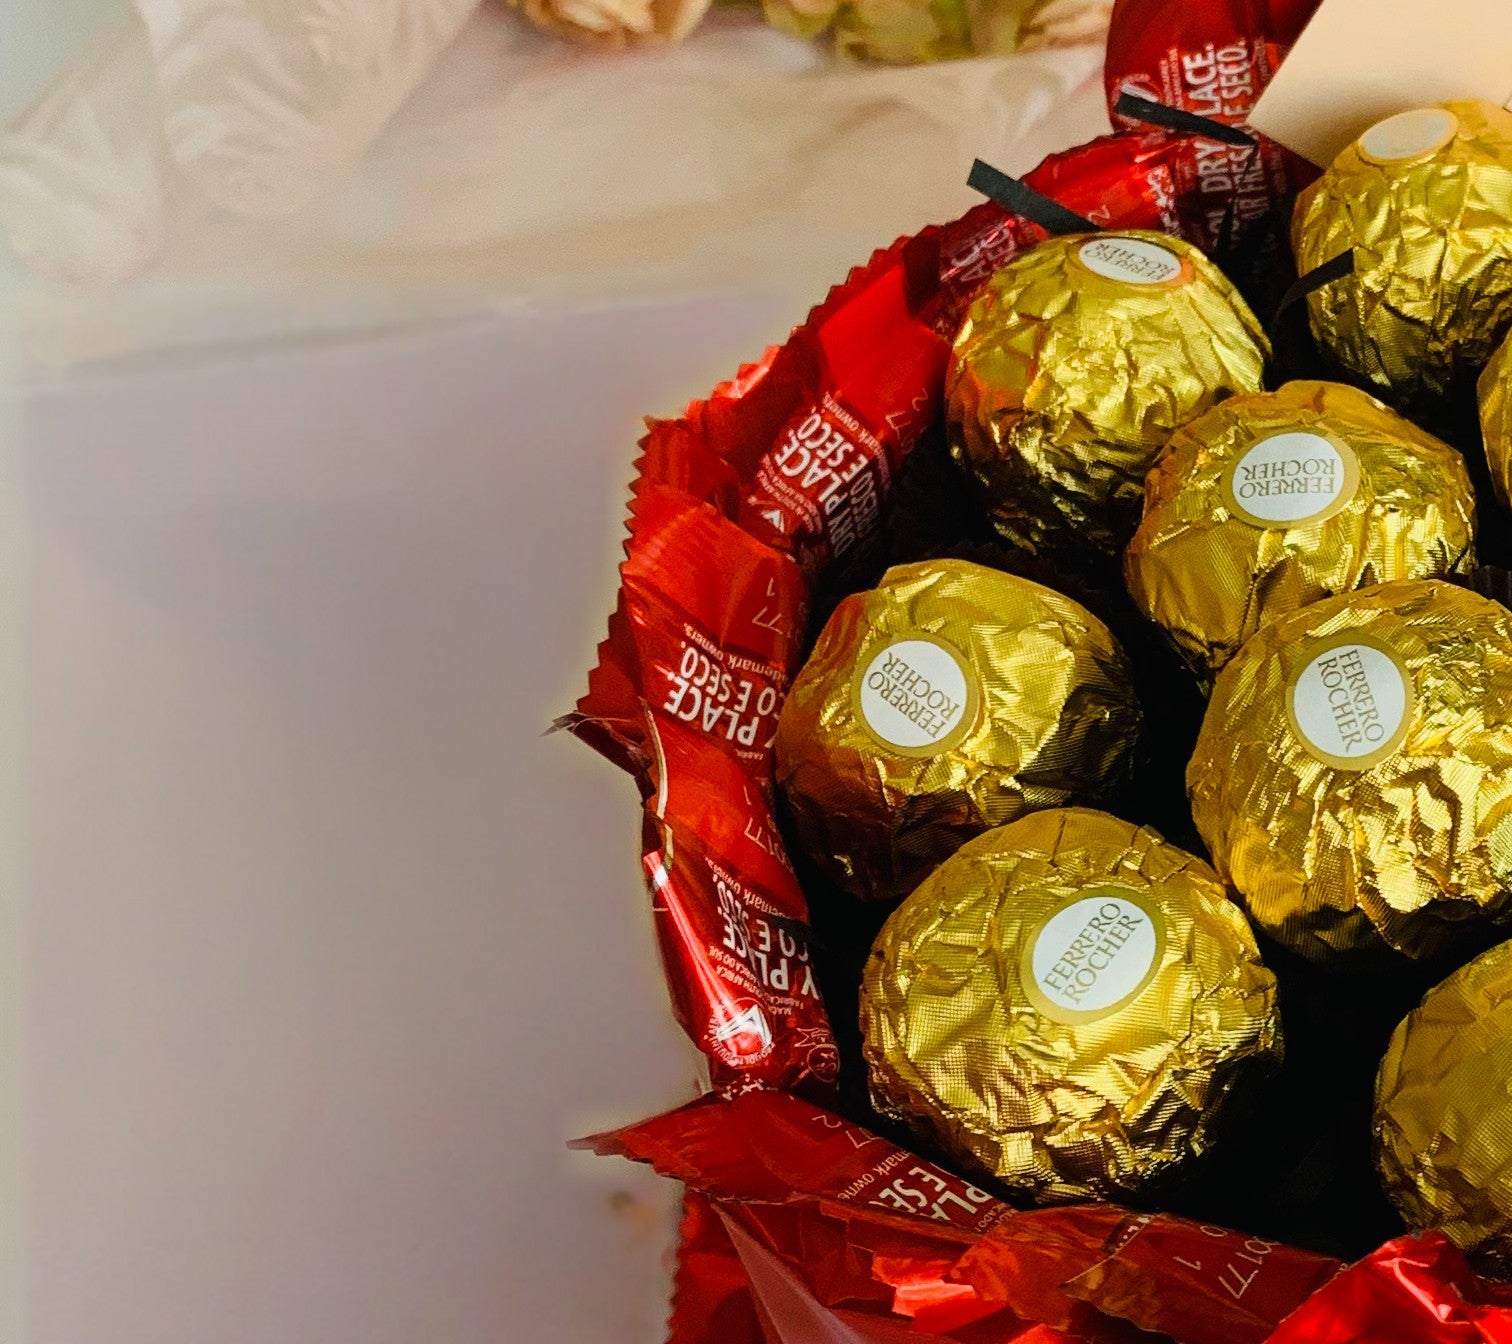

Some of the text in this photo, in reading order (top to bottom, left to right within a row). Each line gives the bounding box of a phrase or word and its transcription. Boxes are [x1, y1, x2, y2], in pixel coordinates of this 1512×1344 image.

[1183, 42, 1222, 117] LACE.
[774, 428, 848, 516] PLACE.
[797, 406, 854, 468] SECO.
[1240, 458, 1336, 481] ROCHER
[1239, 477, 1335, 499] FERRERO
[663, 671, 760, 747] PLACE.
[679, 640, 733, 703] SECO.
[868, 671, 946, 739] FERRERO
[882, 651, 960, 721] ROCHER
[1317, 657, 1363, 753] ROCHER
[1339, 648, 1385, 743] FERRERO
[1043, 903, 1121, 991] FERRERO
[1061, 915, 1144, 1005] ROCHER
